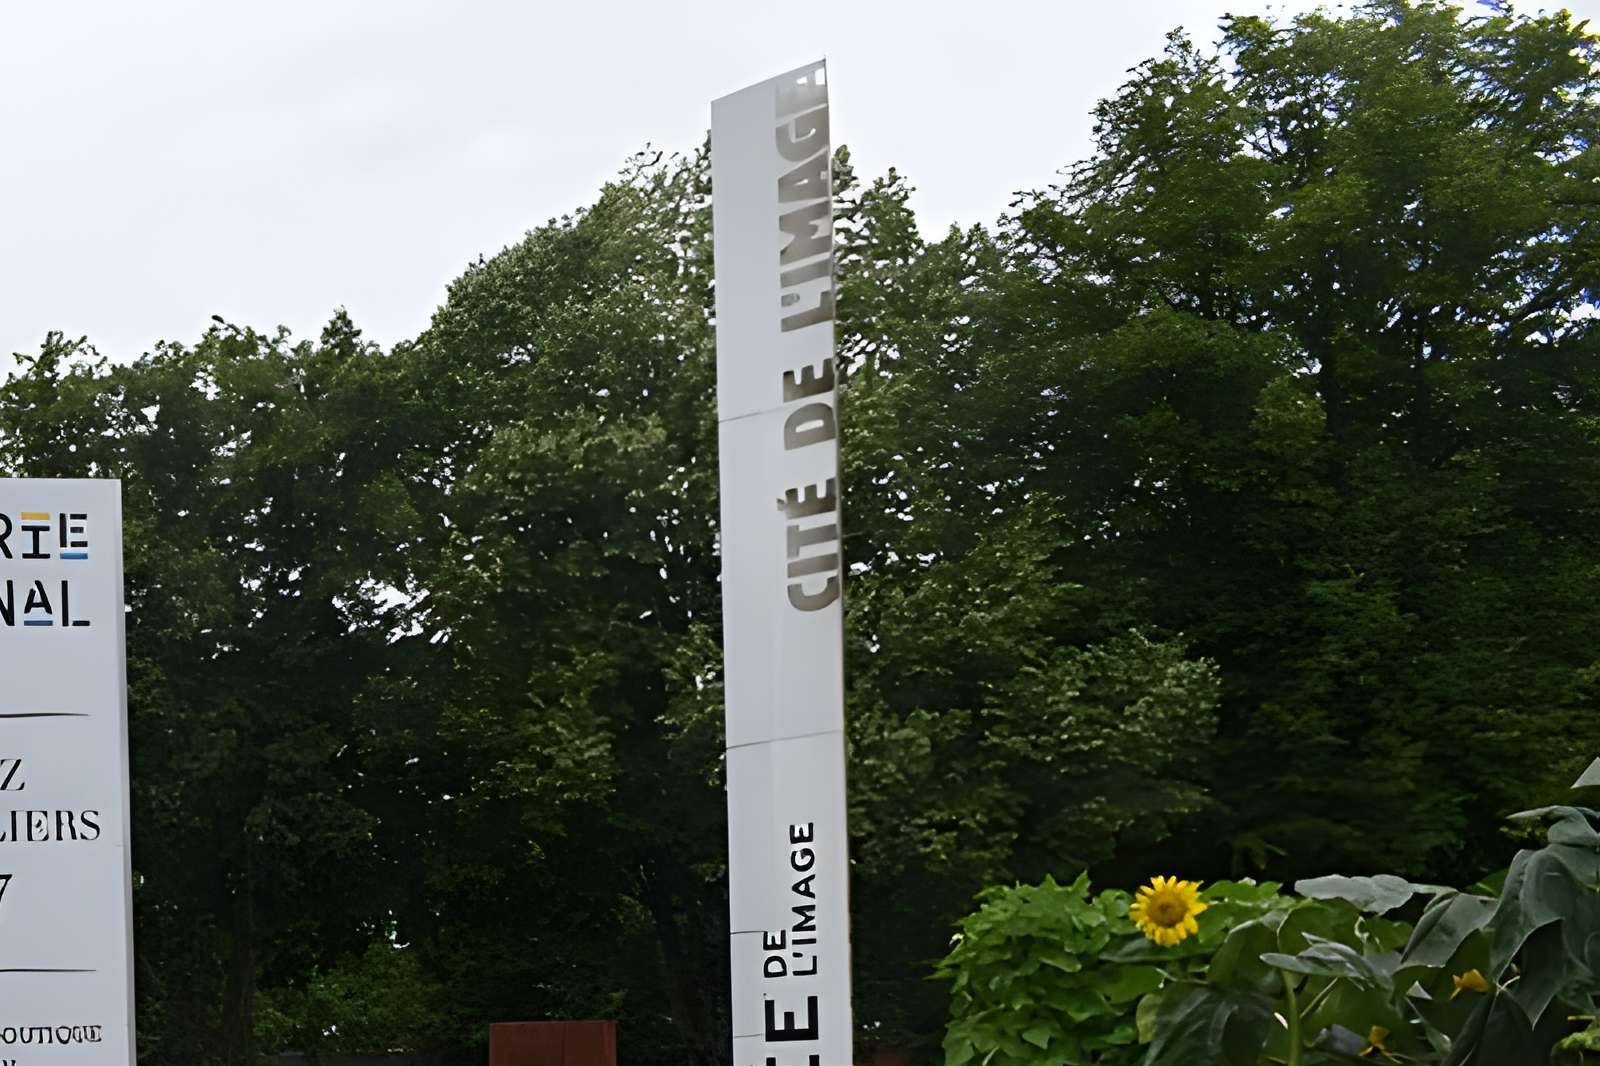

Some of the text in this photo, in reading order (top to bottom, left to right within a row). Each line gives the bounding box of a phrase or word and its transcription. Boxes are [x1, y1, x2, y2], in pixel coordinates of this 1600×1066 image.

[783, 358, 837, 450] DE
[776, 477, 840, 612] CITÉ
[763, 929, 787, 978] DE
[789, 822, 817, 976] L'IMAGE
